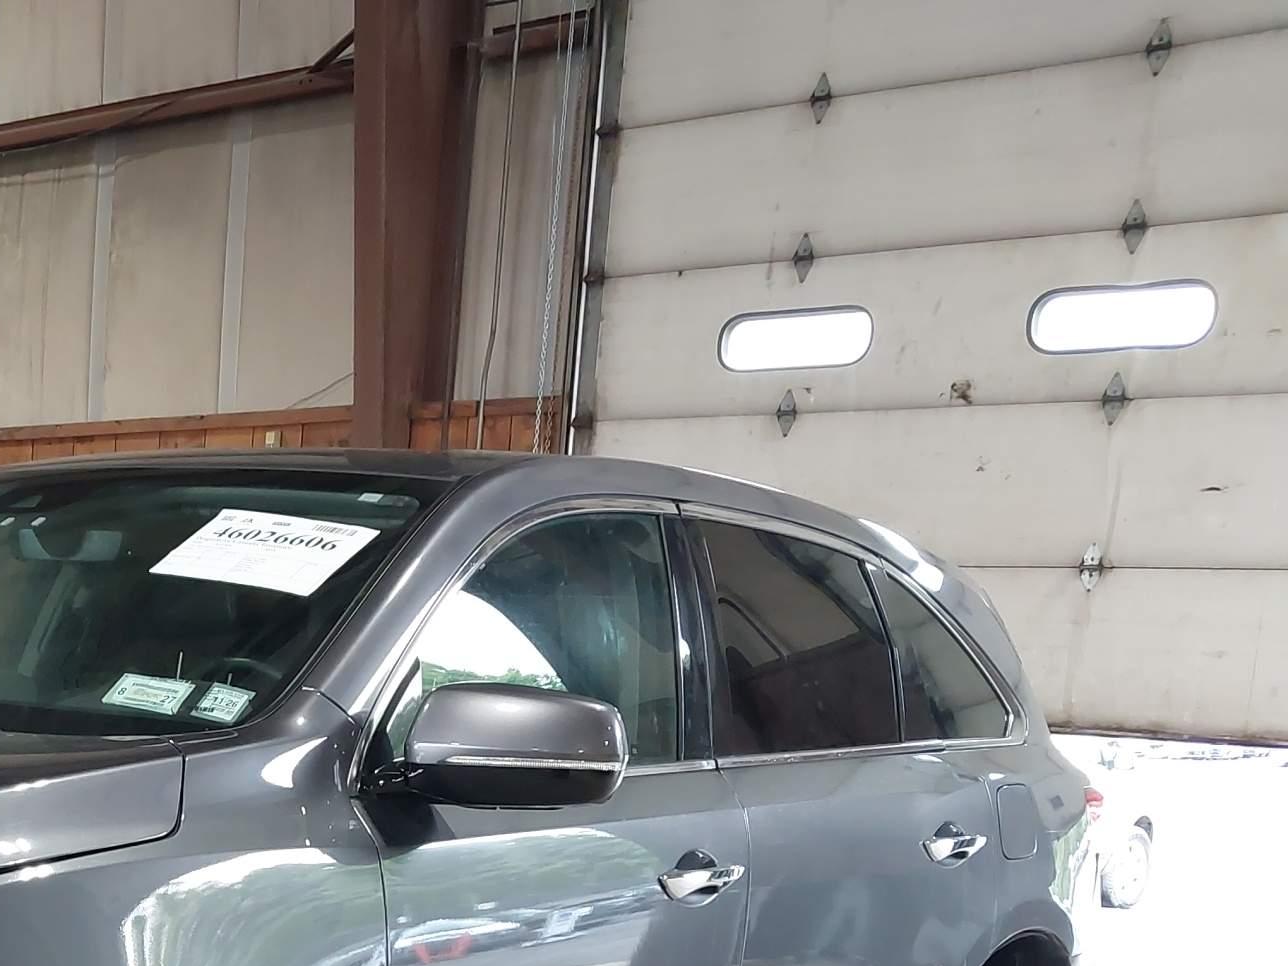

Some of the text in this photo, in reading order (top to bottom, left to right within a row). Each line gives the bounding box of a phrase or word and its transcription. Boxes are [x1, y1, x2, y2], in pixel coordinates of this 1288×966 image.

[212, 526, 344, 552] 46026606
[117, 687, 127, 696] 8
[159, 695, 178, 704] 27
